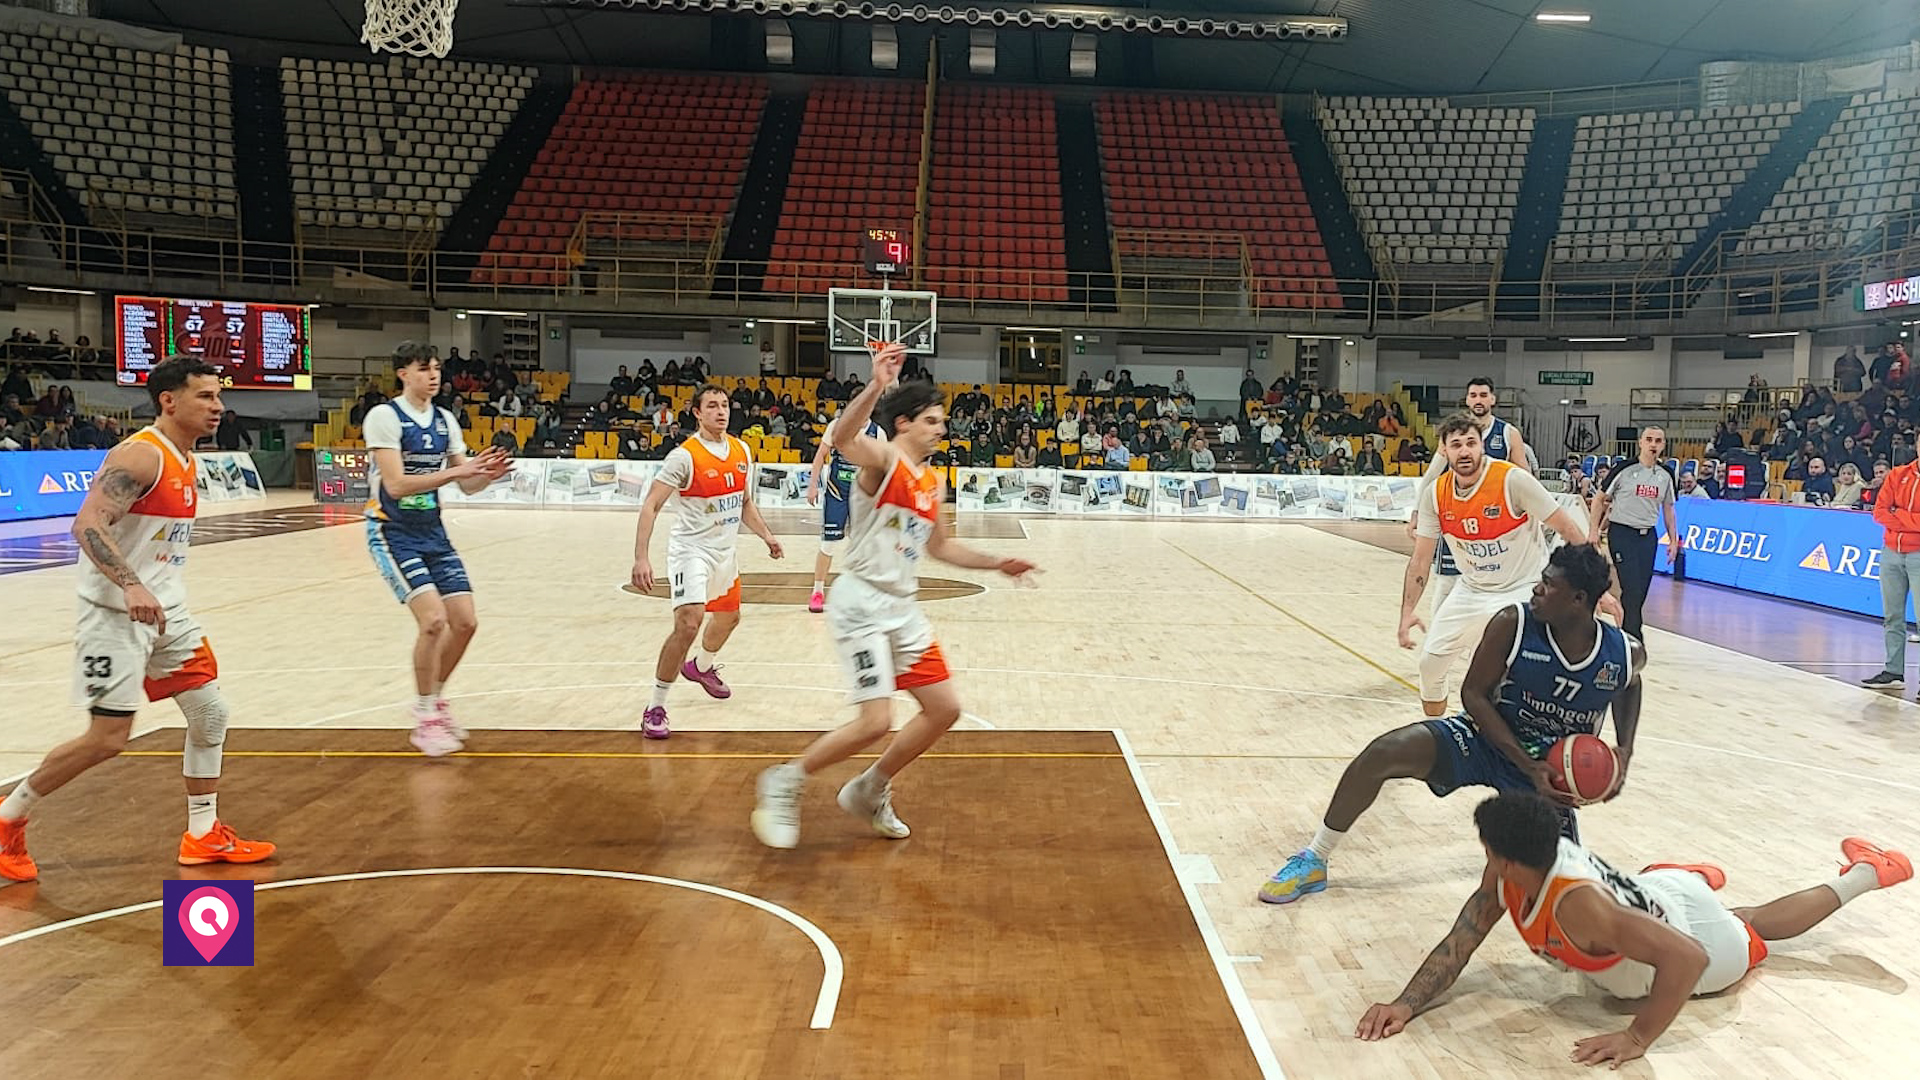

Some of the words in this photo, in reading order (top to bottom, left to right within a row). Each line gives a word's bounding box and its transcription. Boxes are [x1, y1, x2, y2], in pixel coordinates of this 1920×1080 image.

[888, 243, 902, 264] 9
[1886, 280, 1920, 304] SUSH
[185, 319, 205, 331] 67
[226, 321, 245, 334] 57
[421, 433, 434, 449] 2
[723, 471, 736, 488] 11
[1461, 517, 1480, 535] 18
[1683, 524, 1772, 562] REDEL
[675, 573, 684, 586] 11
[83, 656, 112, 678] 33
[1552, 675, 1583, 702] 77
